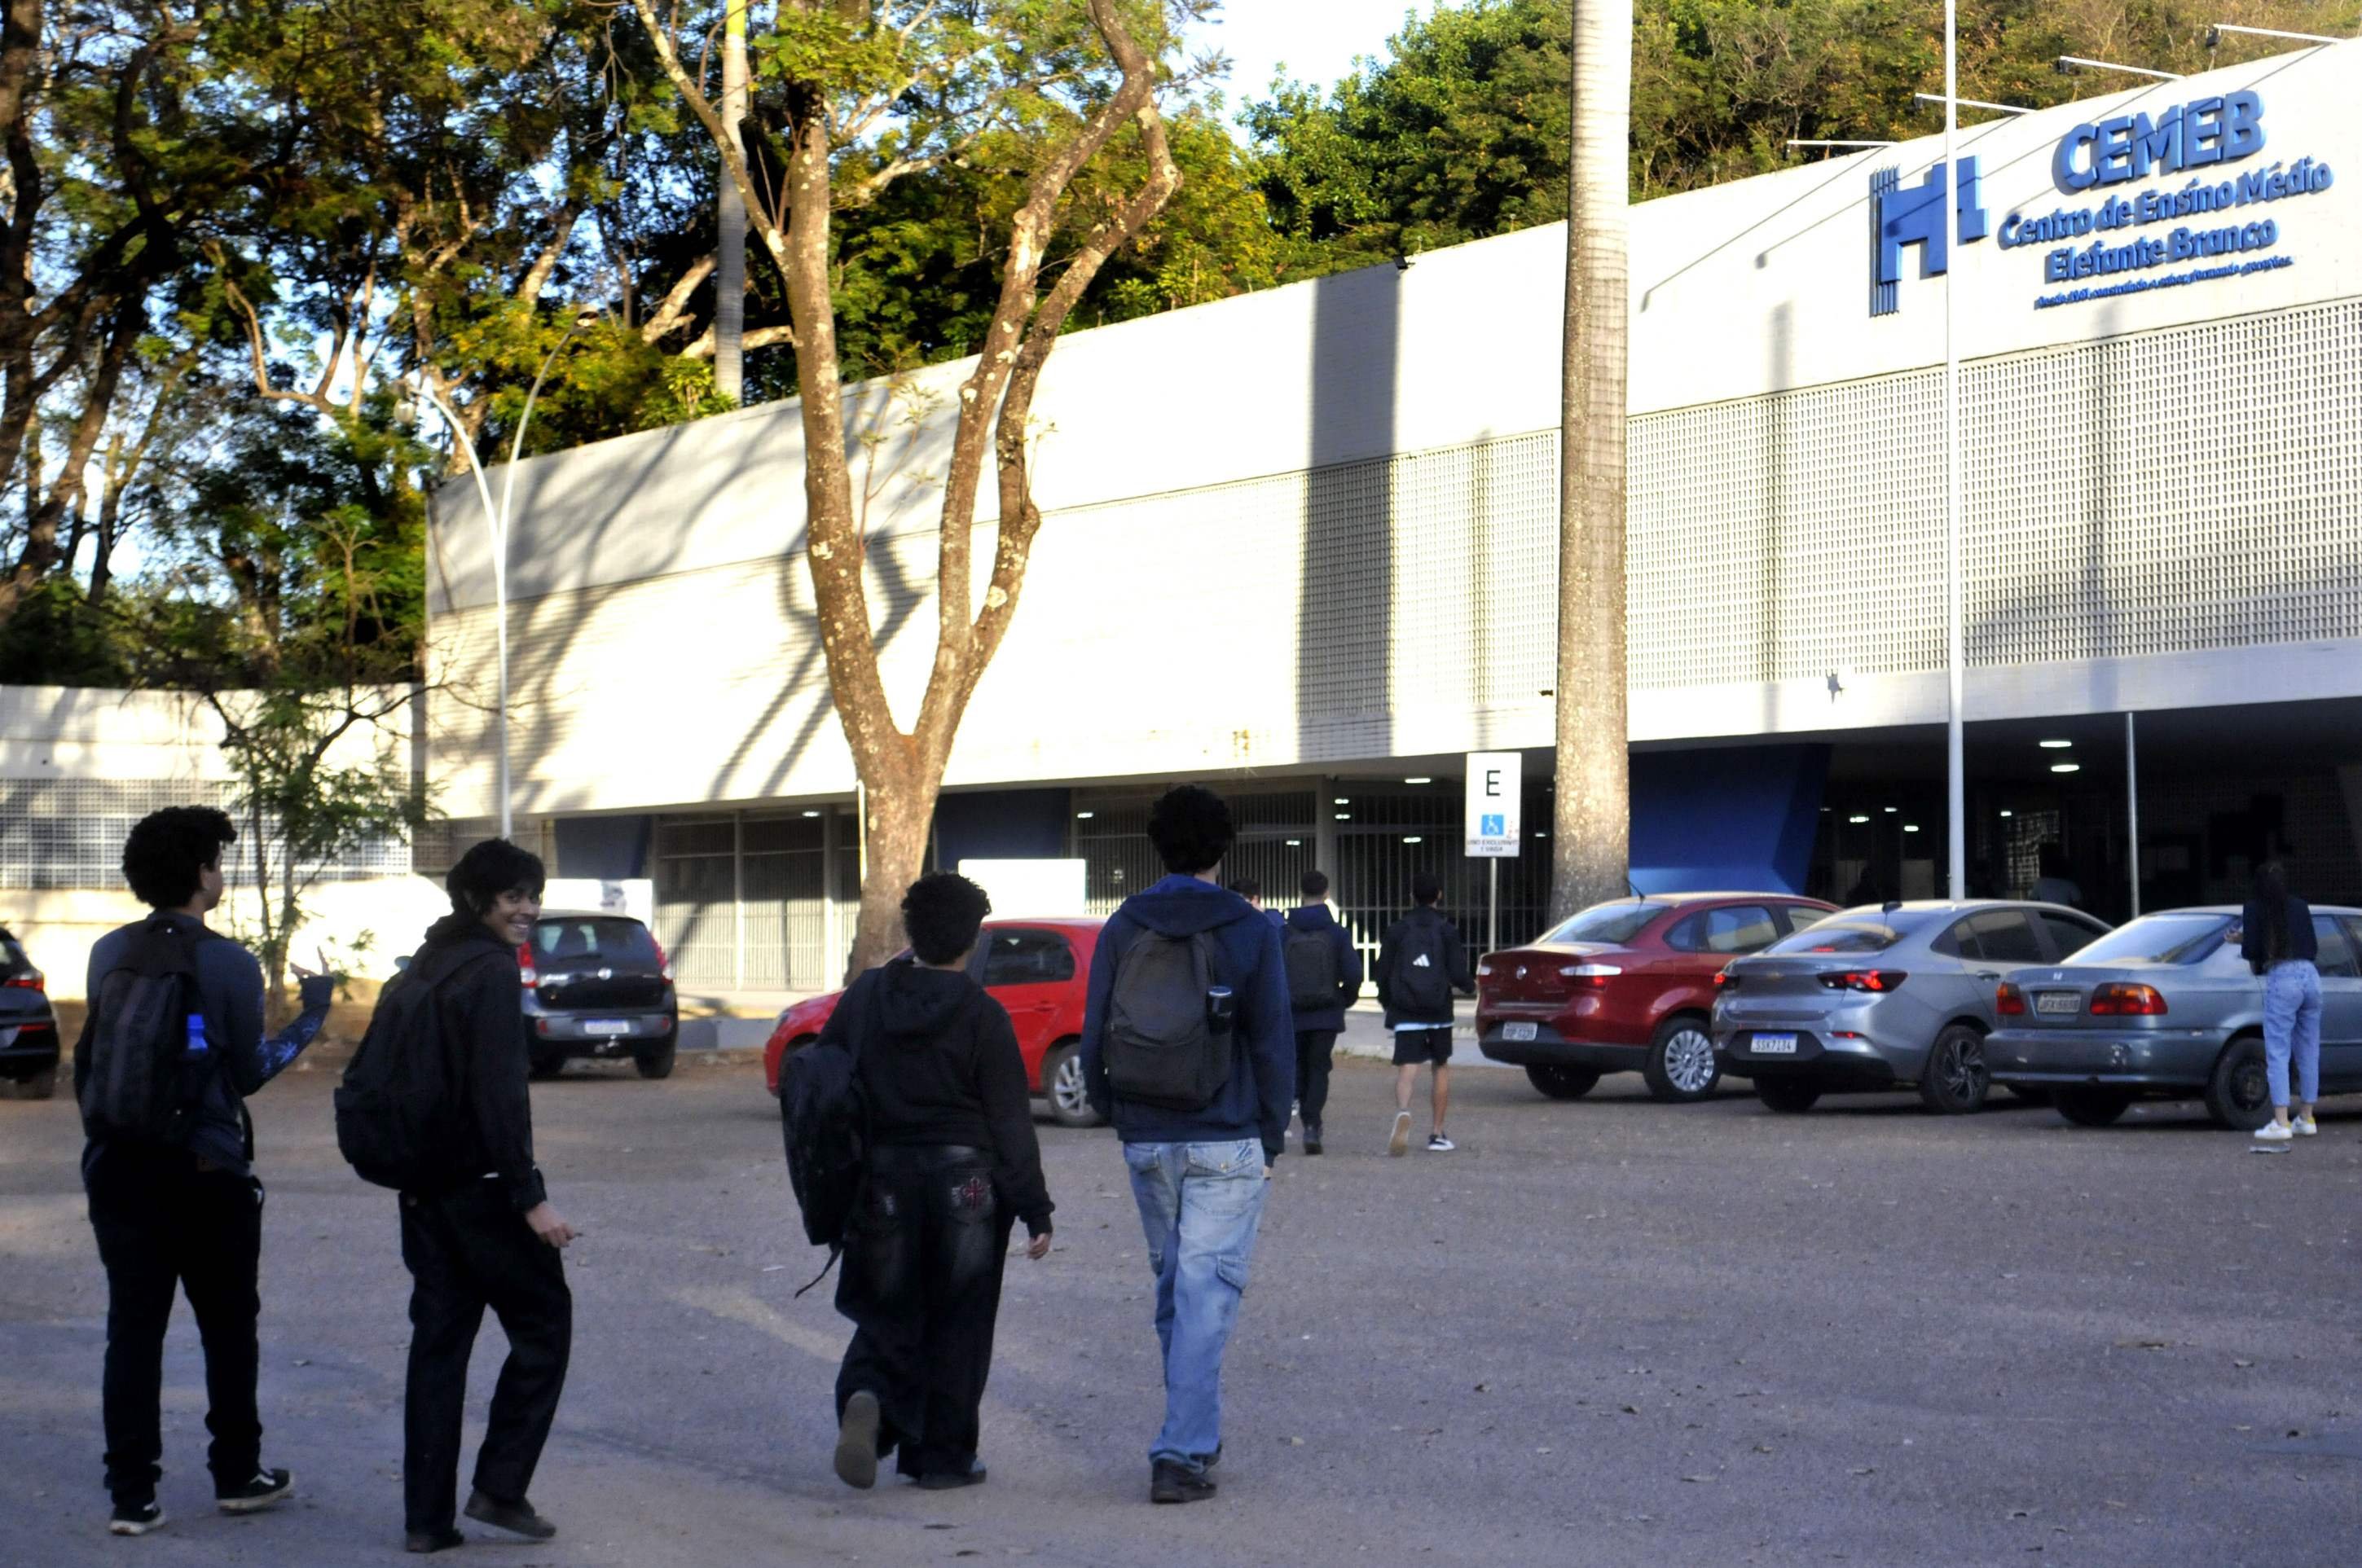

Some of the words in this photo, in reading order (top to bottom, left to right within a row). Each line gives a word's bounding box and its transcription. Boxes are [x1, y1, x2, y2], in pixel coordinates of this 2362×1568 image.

[2057, 90, 2266, 192] CEMEB
[2000, 209, 2092, 248] Centro
[2096, 195, 2134, 231] de
[2237, 156, 2333, 206] Médio
[2048, 236, 2167, 282] Elefante
[2171, 218, 2279, 261] Branco
[1486, 770, 1501, 797] E
